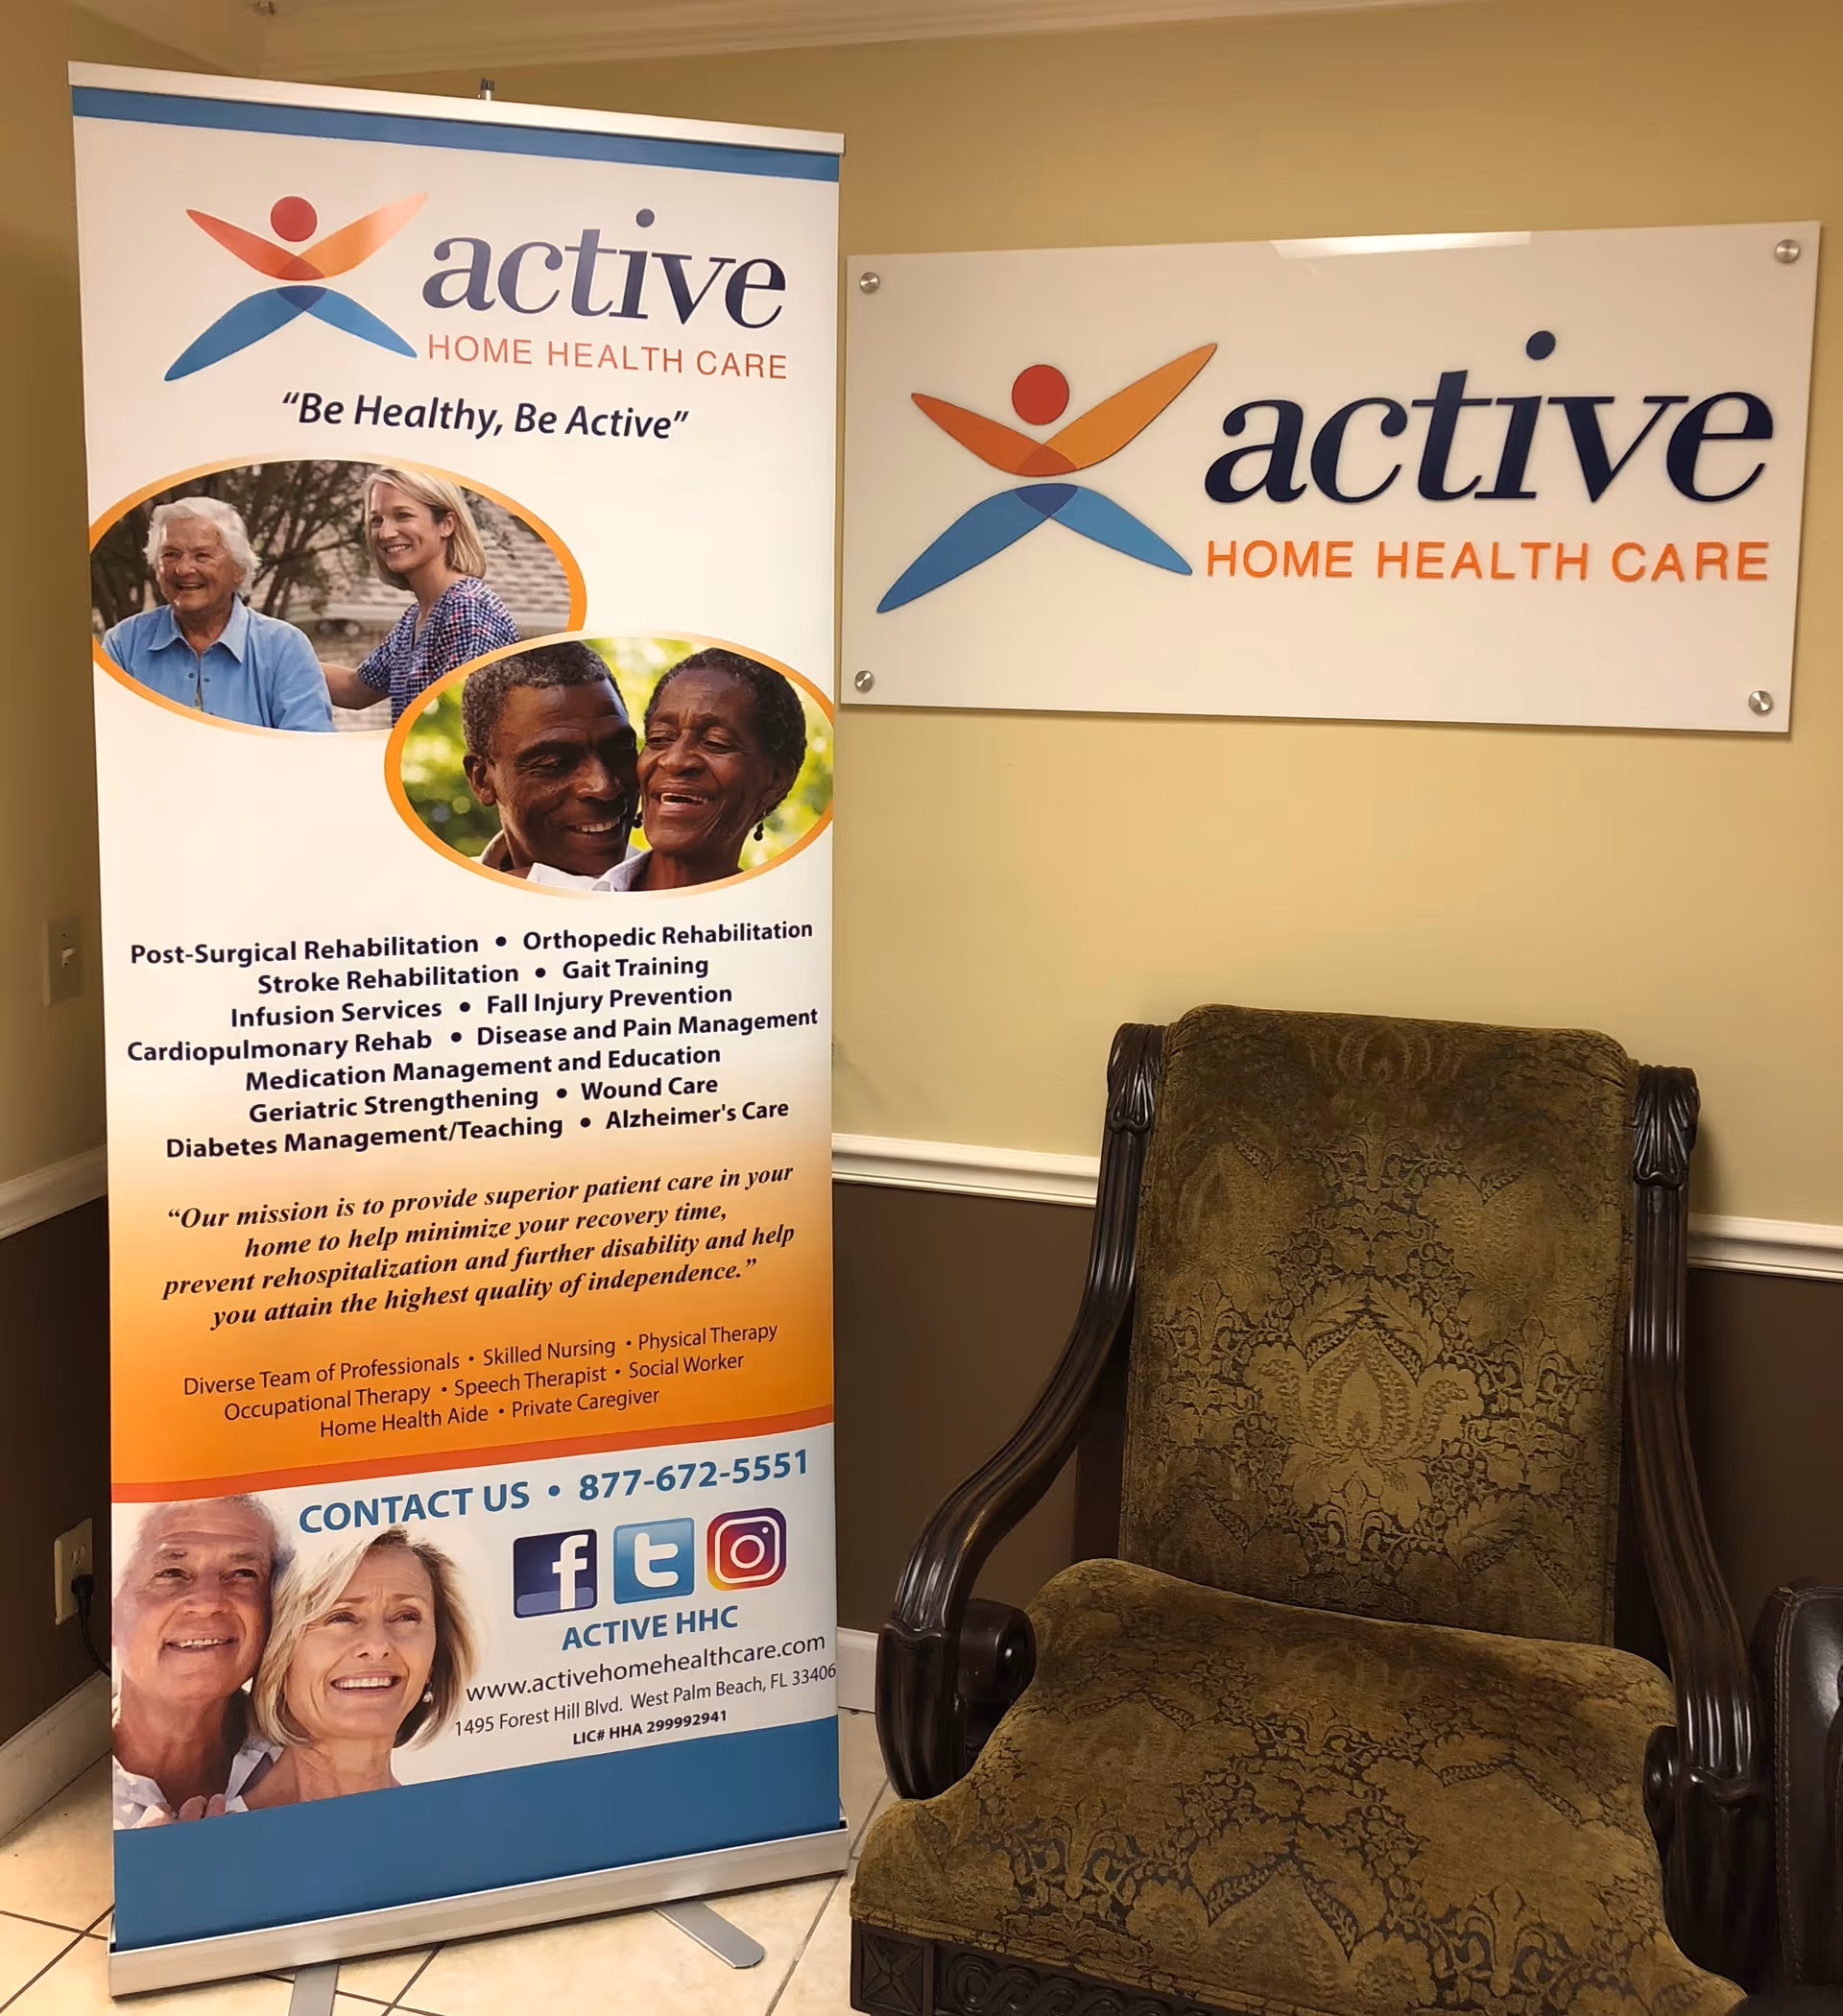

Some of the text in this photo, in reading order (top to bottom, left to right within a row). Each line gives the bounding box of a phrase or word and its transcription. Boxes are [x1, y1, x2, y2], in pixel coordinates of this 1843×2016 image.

[422, 208, 786, 328] active
[429, 334, 786, 379] HOME HEALTH CARE
[354, 395, 503, 440] Healthy,
[515, 403, 557, 434] Be
[1205, 330, 1774, 504] active
[1208, 540, 1769, 583] HOME HEALTH CARE
[132, 921, 812, 968] Post-Surgical Rehabilitation Orthopedic Rehabilitation
[258, 956, 708, 995] Stroke Rehabilitation Gait Training
[232, 985, 731, 1027] Infusion Services Fall Injury Prevention
[128, 1008, 818, 1066] Cardiopulmonary Rehab Disease and Pain Management
[246, 1045, 720, 1091] Medication Management and Education
[250, 1077, 718, 1122] Geriatric Strengthening Wound Care
[167, 1101, 789, 1158] Diabetes Management/Teaching Alzheimer's Care
[236, 1202, 328, 1225] mission
[336, 1197, 355, 1217] is
[363, 1199, 384, 1214] to
[389, 1188, 478, 1218] provide
[484, 1181, 579, 1209] superior
[583, 1176, 661, 1203] patient
[667, 1175, 713, 1191] care
[720, 1168, 740, 1188] in
[745, 1167, 794, 1190] your
[245, 1202, 726, 1258] home to help minimize your recovery time,
[161, 1224, 795, 1300] prevent rehospitalization and further disability and help
[210, 1309, 256, 1332] you
[265, 1297, 332, 1321] attain
[341, 1293, 377, 1313] the
[384, 1286, 468, 1312] highest
[475, 1278, 553, 1307] quality
[560, 1273, 586, 1298] of
[184, 1325, 778, 1395] Diverse Team of Professionals Skilled Nursing Physical Therapy
[225, 1353, 744, 1421] Occupational Therapy Speech Therapist Social Worker
[321, 1389, 659, 1438] Home Health Aide Private Caregiver
[299, 1449, 806, 1533] CONTACT US 877-672-5551
[562, 1605, 738, 1651] ACTIVE HHC
[466, 1635, 826, 1702] www.activehomehealthcare.com
[455, 1663, 836, 1736] 1495 Forest Hill Blvd. West Palm Beach, FL 33406
[573, 1710, 726, 1745] LIC# HHA 299992941
